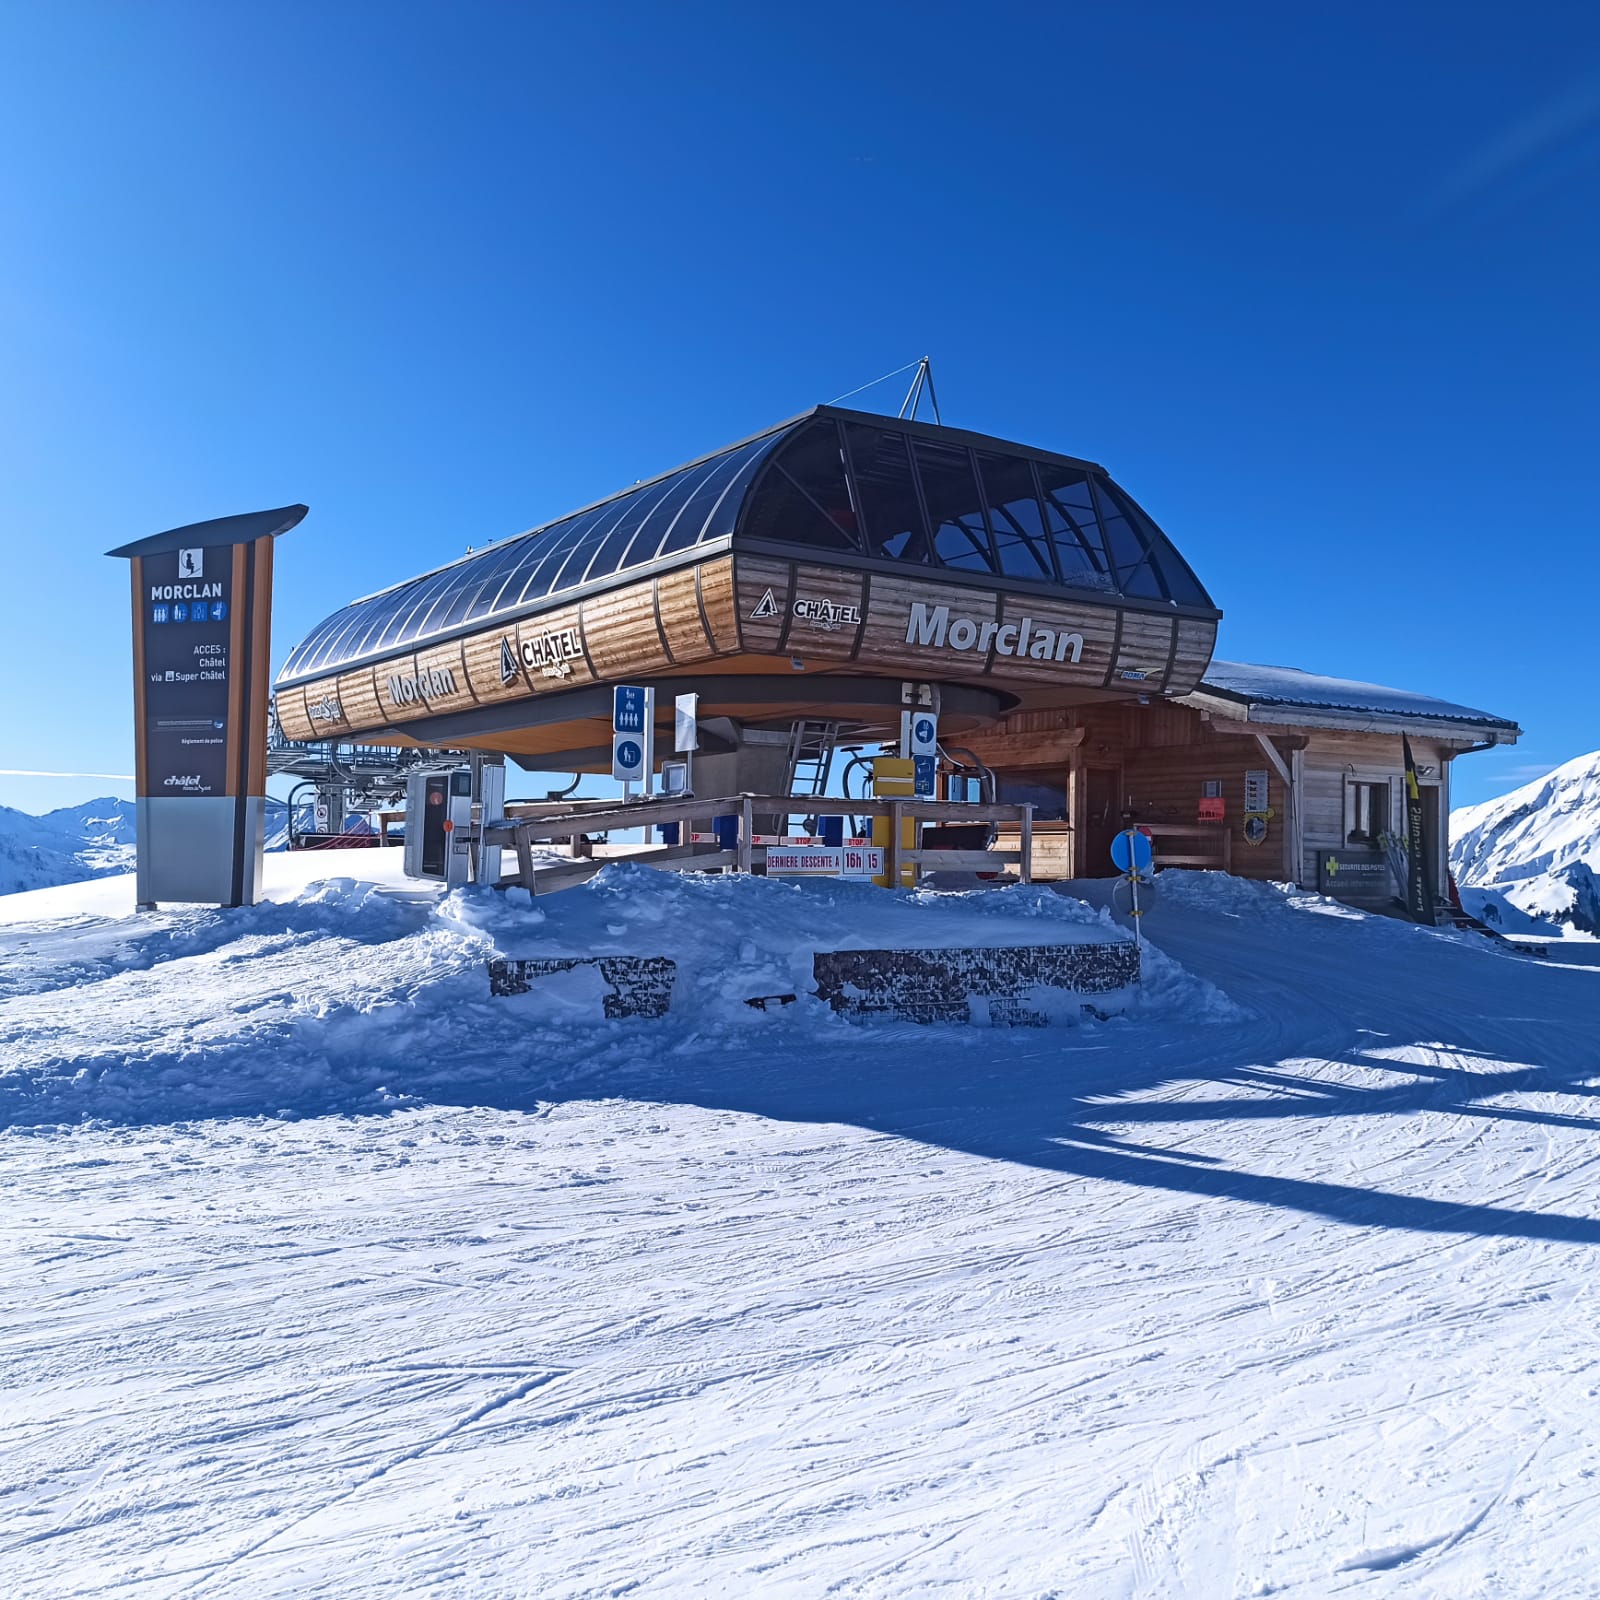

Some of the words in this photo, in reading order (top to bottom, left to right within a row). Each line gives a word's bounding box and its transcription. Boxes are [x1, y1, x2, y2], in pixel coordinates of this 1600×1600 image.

[151, 583, 222, 600] MORCLAN
[794, 599, 860, 623] CHÂTEL
[906, 603, 1083, 663] Morclan
[193, 645, 221, 655] ACCES
[521, 629, 582, 667] CHÂTEL
[200, 658, 226, 667] Châtel
[151, 673, 162, 682] via
[175, 672, 199, 683] Super
[200, 670, 226, 680] Châtel
[387, 665, 455, 704] Morclan
[768, 855, 798, 868] DERNIERE
[801, 855, 833, 868] DESCENTE
[845, 853, 862, 868] 16h
[868, 854, 878, 868] 15
